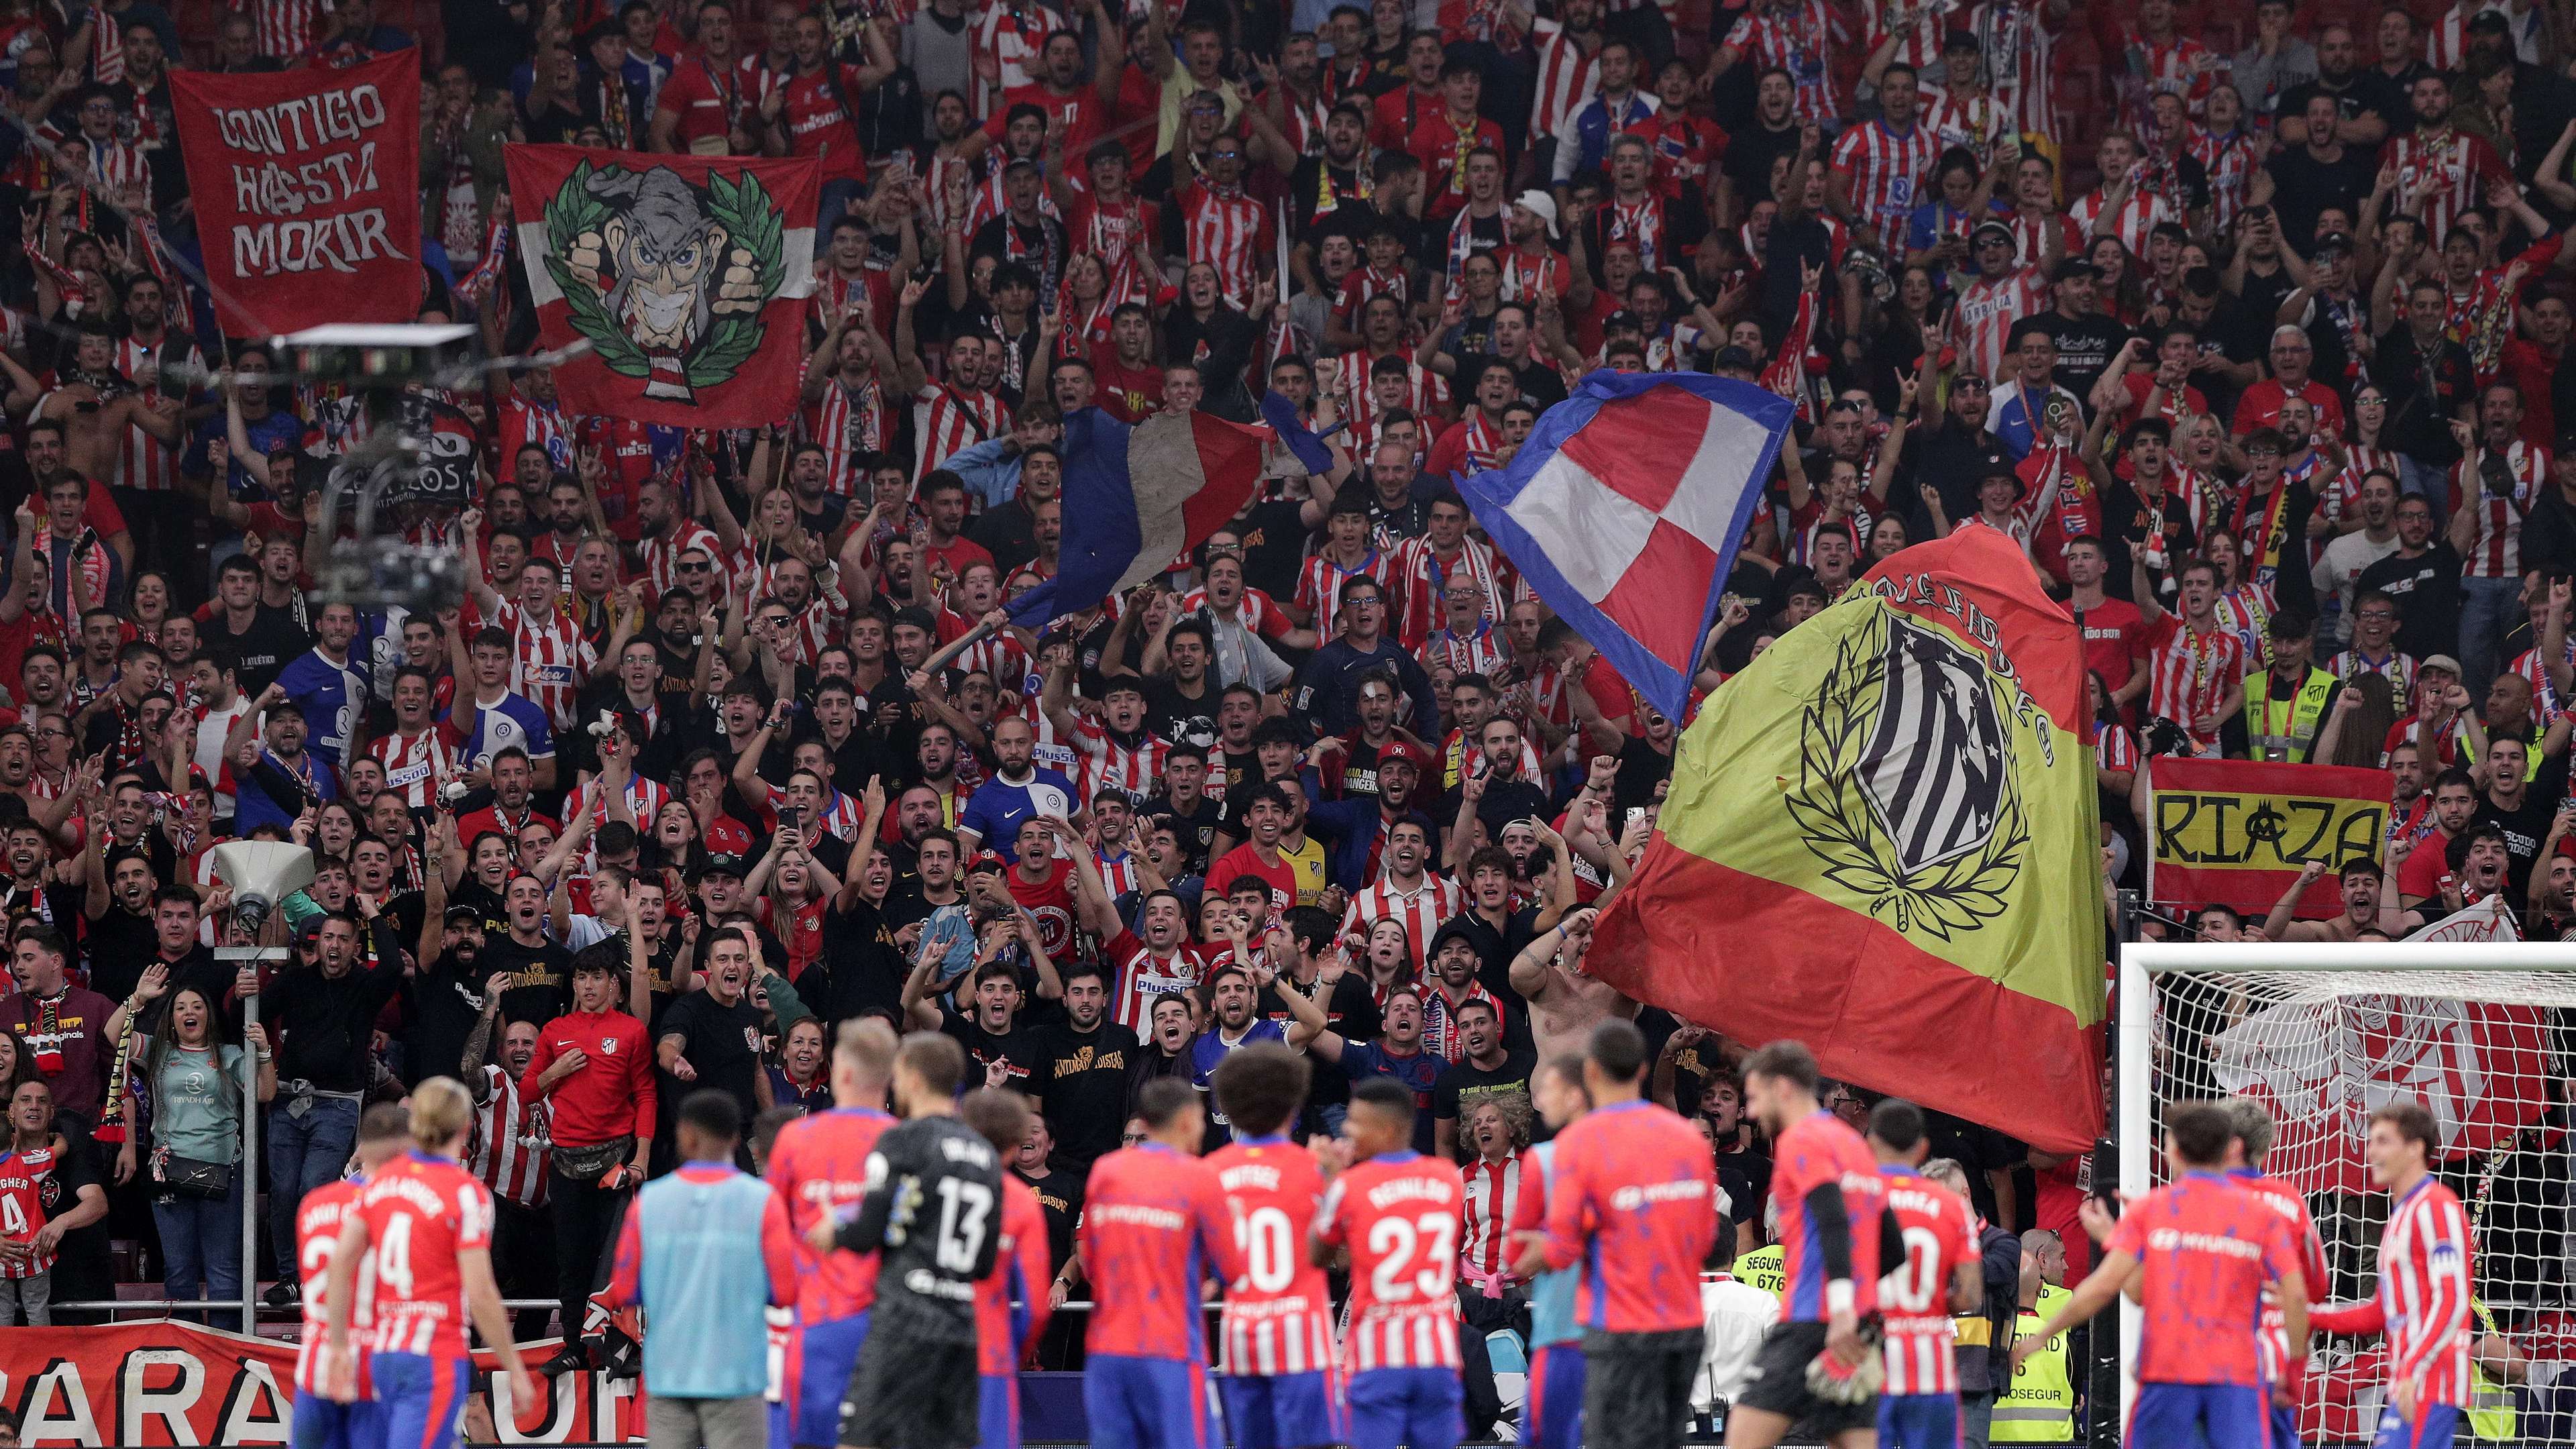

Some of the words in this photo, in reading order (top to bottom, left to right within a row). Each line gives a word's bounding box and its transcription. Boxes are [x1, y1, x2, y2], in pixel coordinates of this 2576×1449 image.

[1362, 770, 1377, 781] BAD
[2154, 794, 2382, 870] RIAZA
[174, 1096, 202, 1105] RIYADH
[203, 1095, 215, 1106] AIR
[1, 1192, 28, 1234] 4
[936, 1175, 994, 1274] 13
[378, 1211, 413, 1301] 4
[1367, 1211, 1456, 1303] 23
